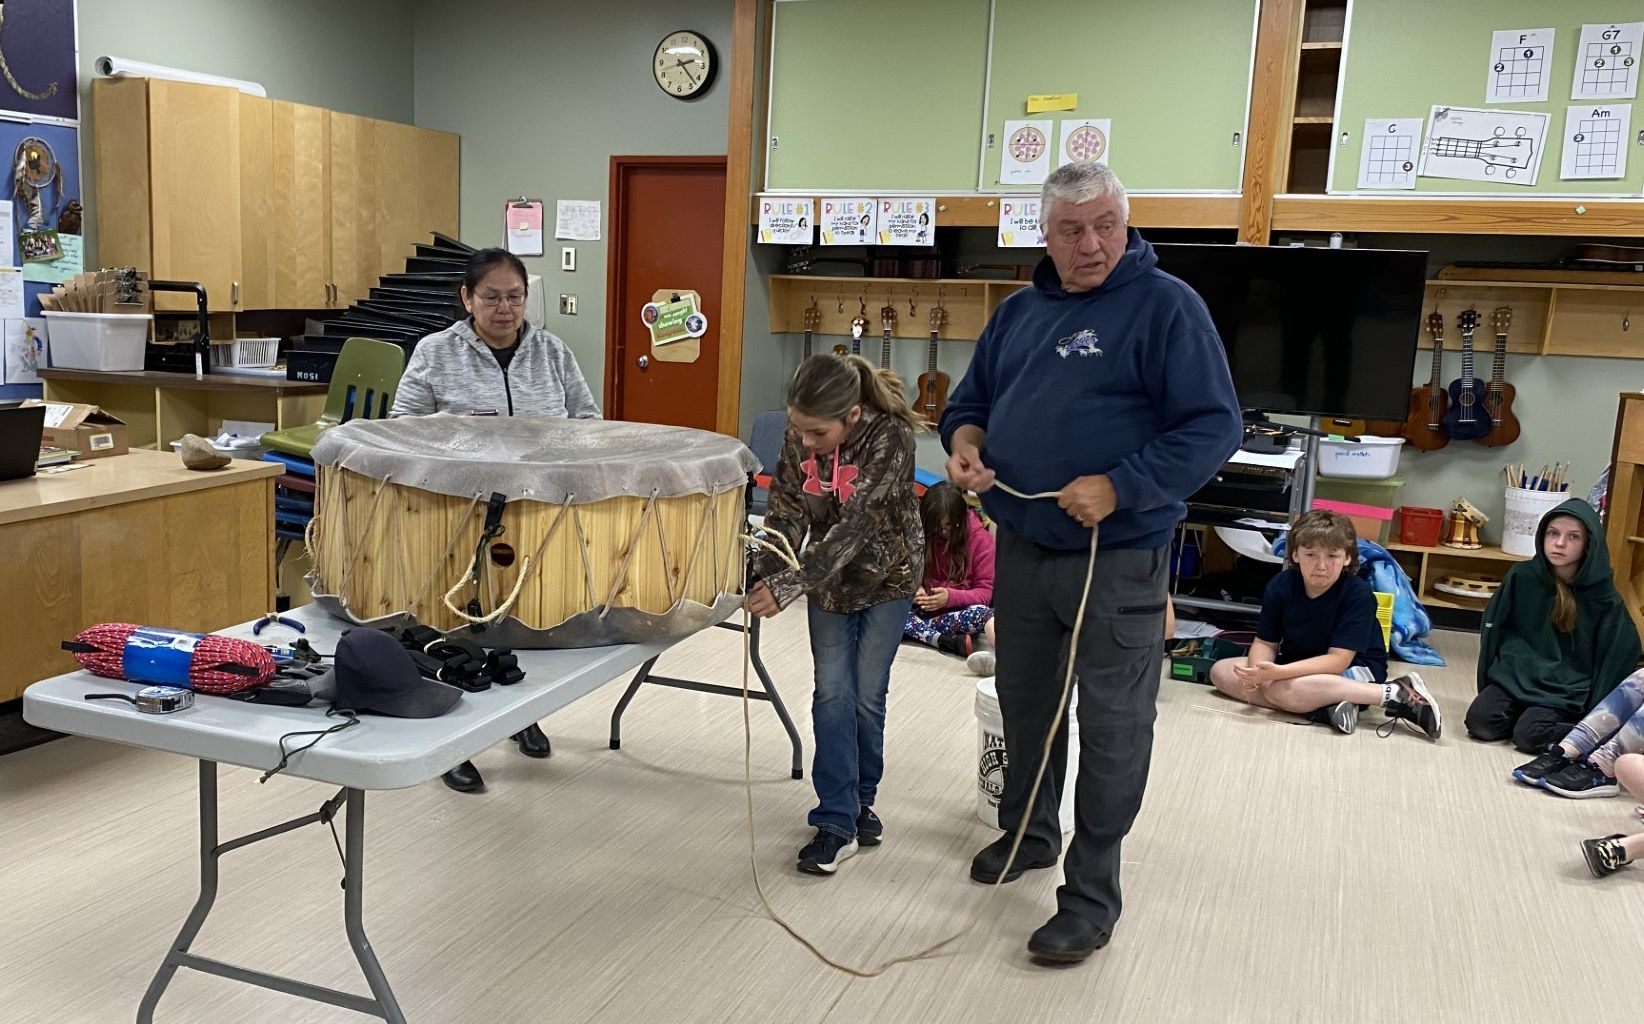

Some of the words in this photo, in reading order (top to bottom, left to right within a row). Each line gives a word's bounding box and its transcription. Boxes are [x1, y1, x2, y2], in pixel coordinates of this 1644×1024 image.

[1519, 34, 1527, 44] F
[1602, 30, 1621, 40] G7
[1591, 109, 1610, 118] Am
[764, 202, 792, 215] RULE
[796, 203, 810, 216] #1
[826, 203, 854, 214] RULE
[857, 202, 872, 214] #2
[884, 202, 912, 214] RULE
[916, 202, 930, 214] #3
[1004, 203, 1036, 216] RULE
[960, 288, 968, 296] 7
[980, 751, 999, 776] HIGH
